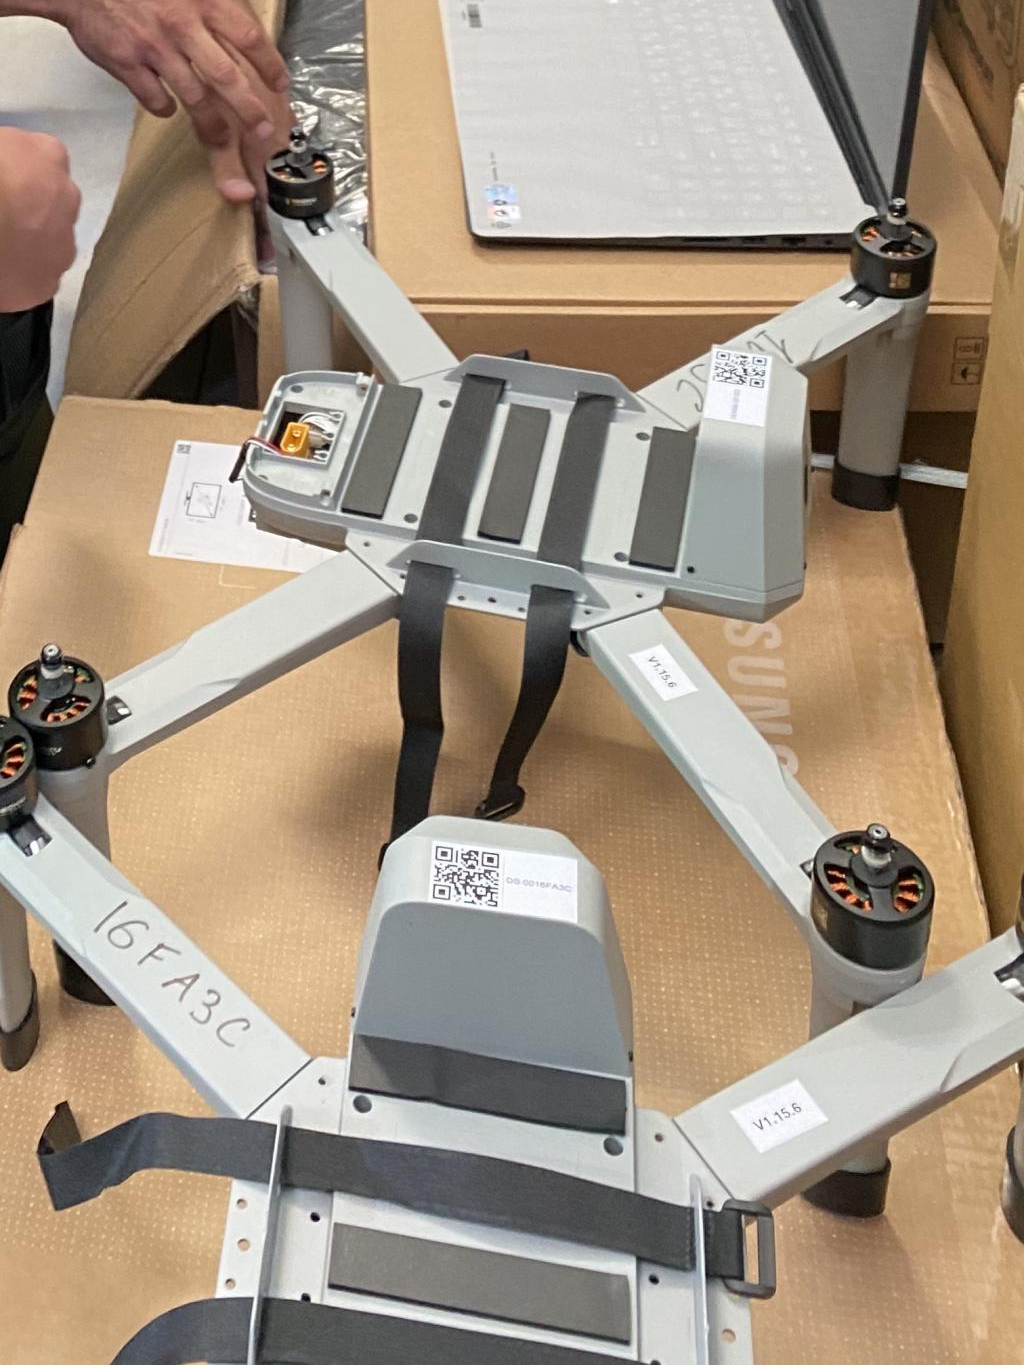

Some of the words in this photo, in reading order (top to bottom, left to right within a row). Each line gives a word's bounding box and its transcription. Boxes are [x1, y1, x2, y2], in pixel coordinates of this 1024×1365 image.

[648, 655, 678, 688] V1.15.6
[93, 900, 251, 1048] 16FA3C
[752, 1102, 802, 1131] V1.15.6
